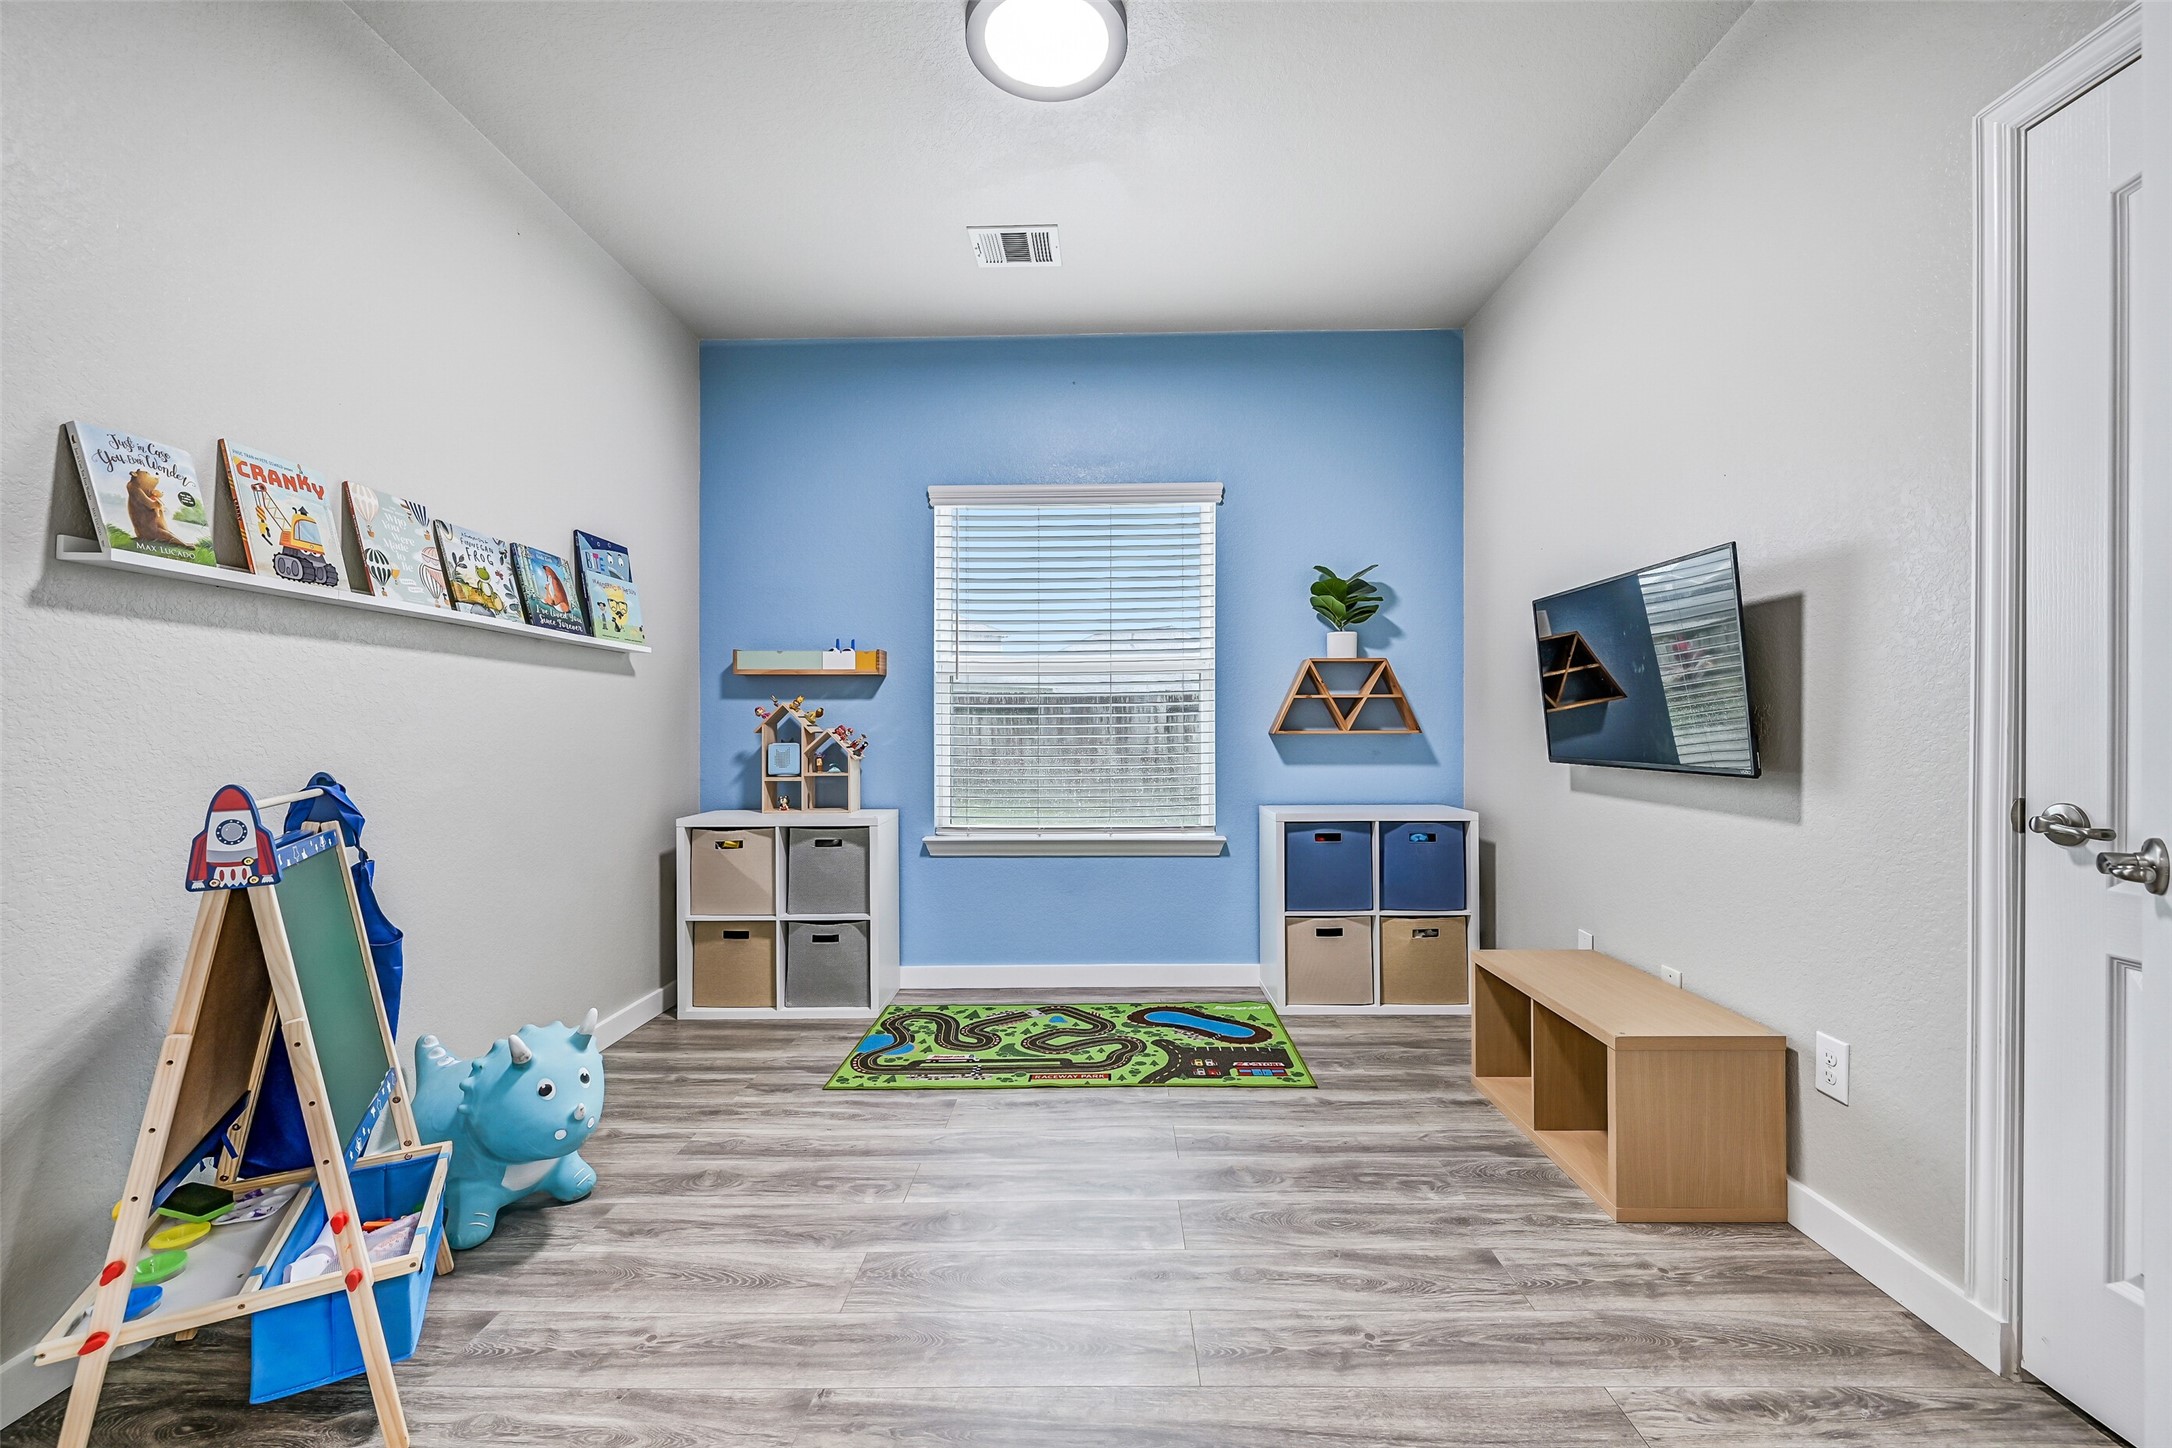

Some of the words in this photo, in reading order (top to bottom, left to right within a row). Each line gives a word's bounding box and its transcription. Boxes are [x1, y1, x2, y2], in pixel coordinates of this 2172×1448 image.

[107, 433, 134, 452] Just
[137, 443, 147, 453] in
[147, 443, 171, 462] Case
[91, 449, 125, 473] You
[138, 454, 196, 487] Wonder
[236, 460, 324, 500] CRANKY
[465, 546, 494, 566] FROG
